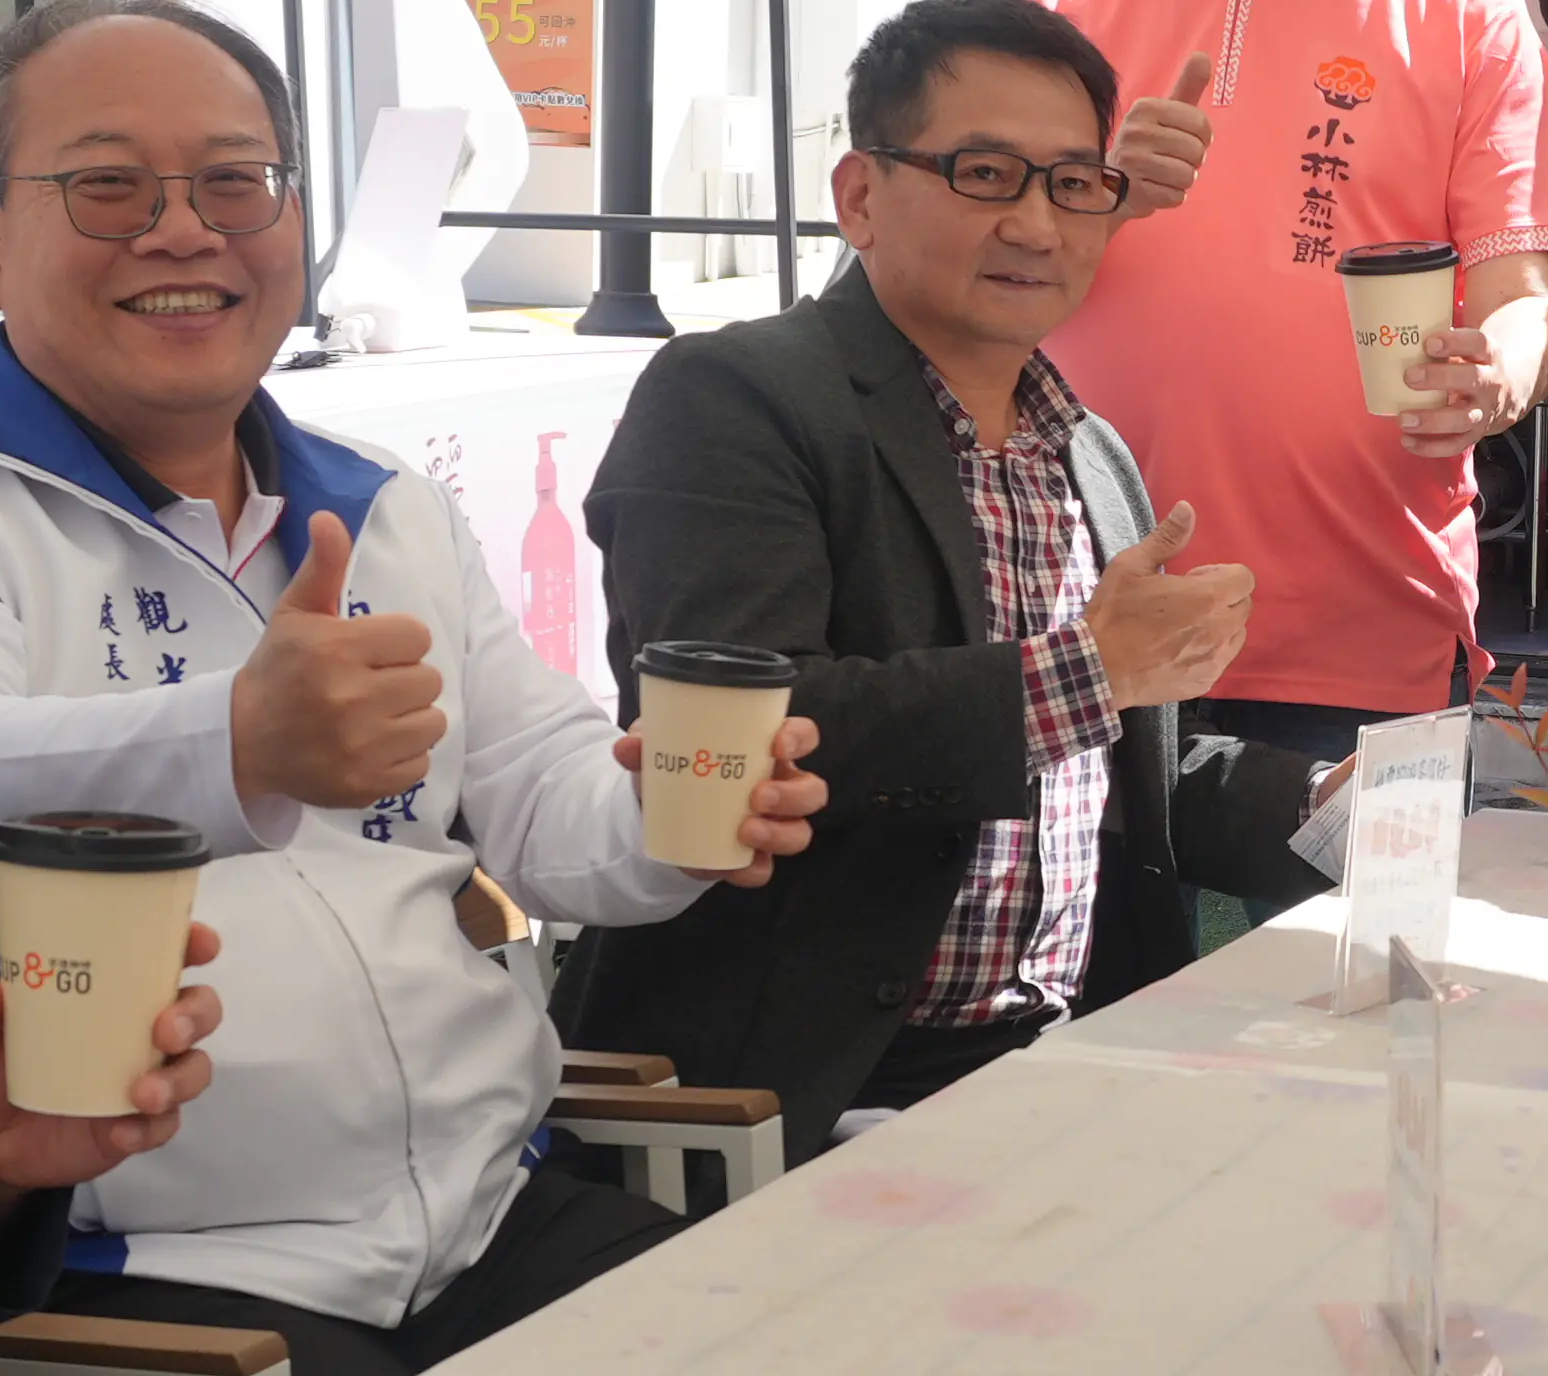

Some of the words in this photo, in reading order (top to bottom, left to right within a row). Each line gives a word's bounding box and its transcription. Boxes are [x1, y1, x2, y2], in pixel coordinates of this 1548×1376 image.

[1292, 117, 1356, 269] 小林煎餅
[1355, 330, 1378, 347] CUP
[1400, 330, 1420, 346] GO
[654, 751, 690, 775] CUP
[720, 761, 745, 780] GO
[1, 958, 21, 985] UP
[56, 969, 92, 995] GO
